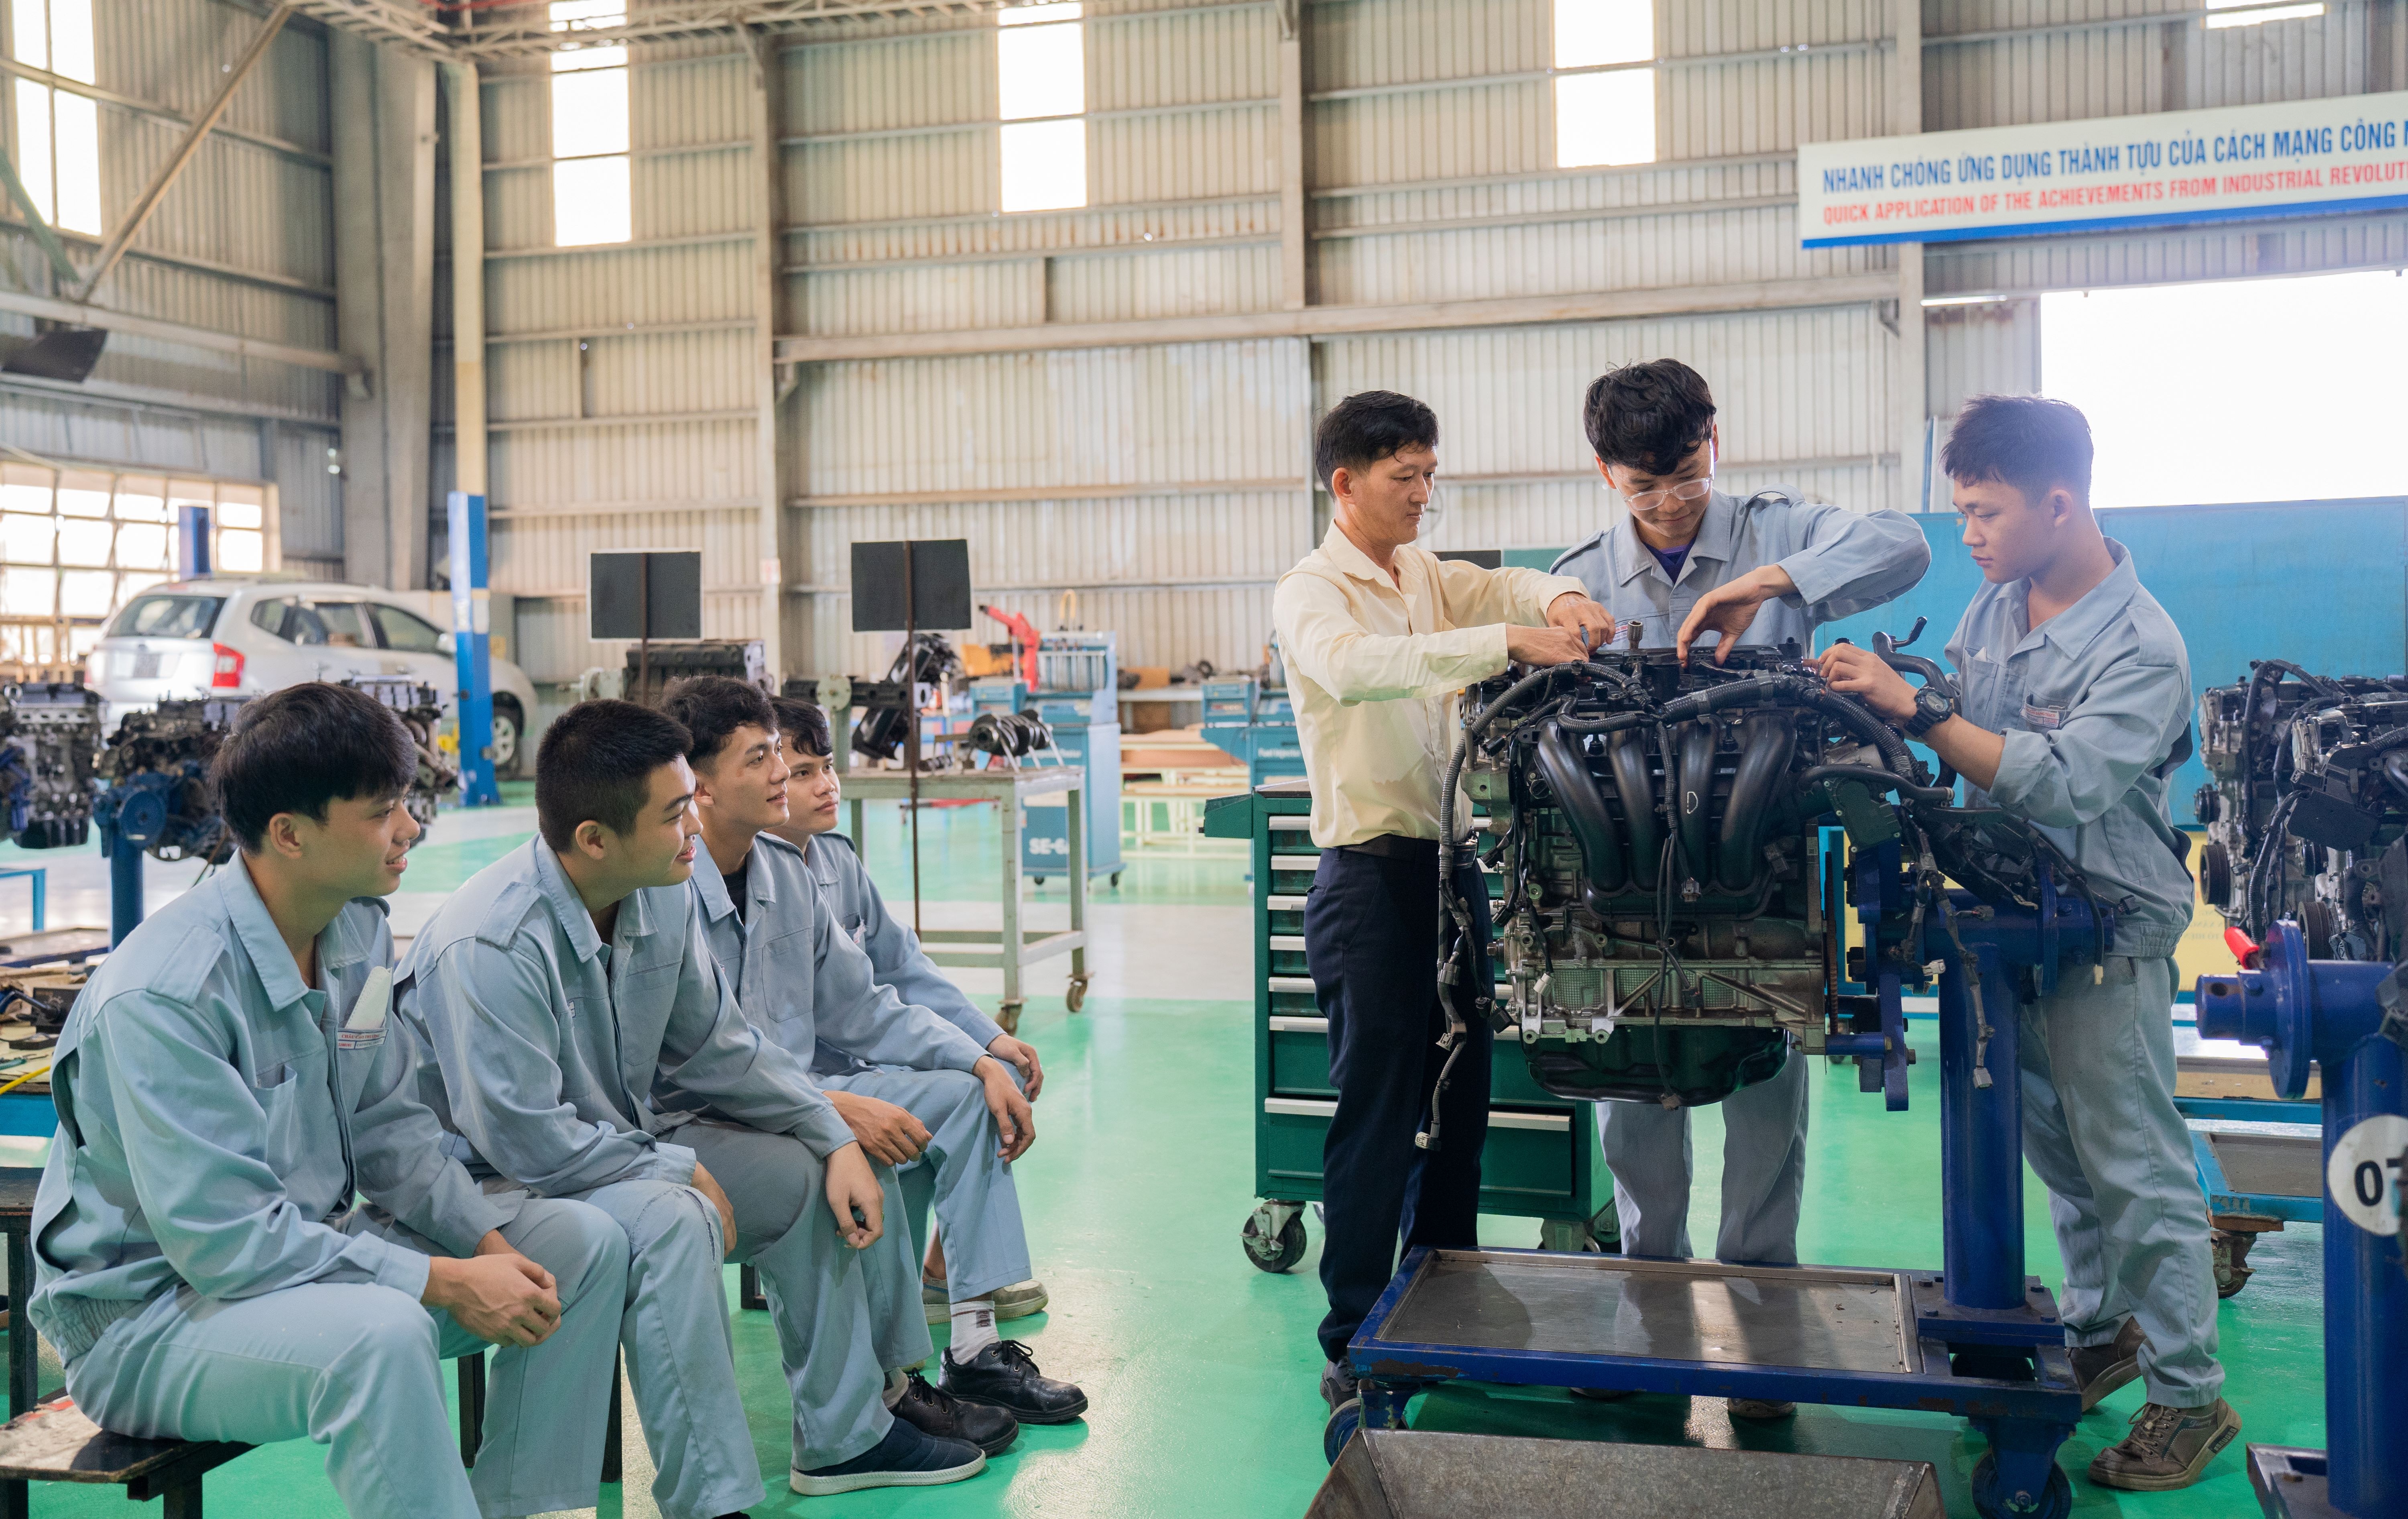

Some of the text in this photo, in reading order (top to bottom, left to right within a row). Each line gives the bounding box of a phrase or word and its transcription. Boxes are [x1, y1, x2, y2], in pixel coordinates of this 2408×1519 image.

[1824, 165, 1884, 193] NHANH
[1890, 155, 1951, 188] CHÓNG
[1958, 152, 1995, 183] ỨNG
[2001, 151, 2052, 185] DỤNG
[2058, 141, 2119, 174] THÀNH
[2126, 141, 2161, 176] TỰU
[2168, 129, 2206, 167] CỦA
[2214, 129, 2266, 163] CÁCH
[2273, 127, 2333, 163] MẠNG
[2340, 118, 2396, 152] CÔNG
[1824, 203, 1869, 226] QUICK
[1874, 195, 1975, 221] APPLICATION
[1979, 193, 1999, 213] OF
[2004, 190, 2032, 211] THE
[2038, 181, 2164, 209] ACHIEVEMENTS
[2169, 175, 2217, 198] FROM
[2222, 166, 2323, 195] INDUSTRIAL
[2354, 1158, 2404, 1207] 0
